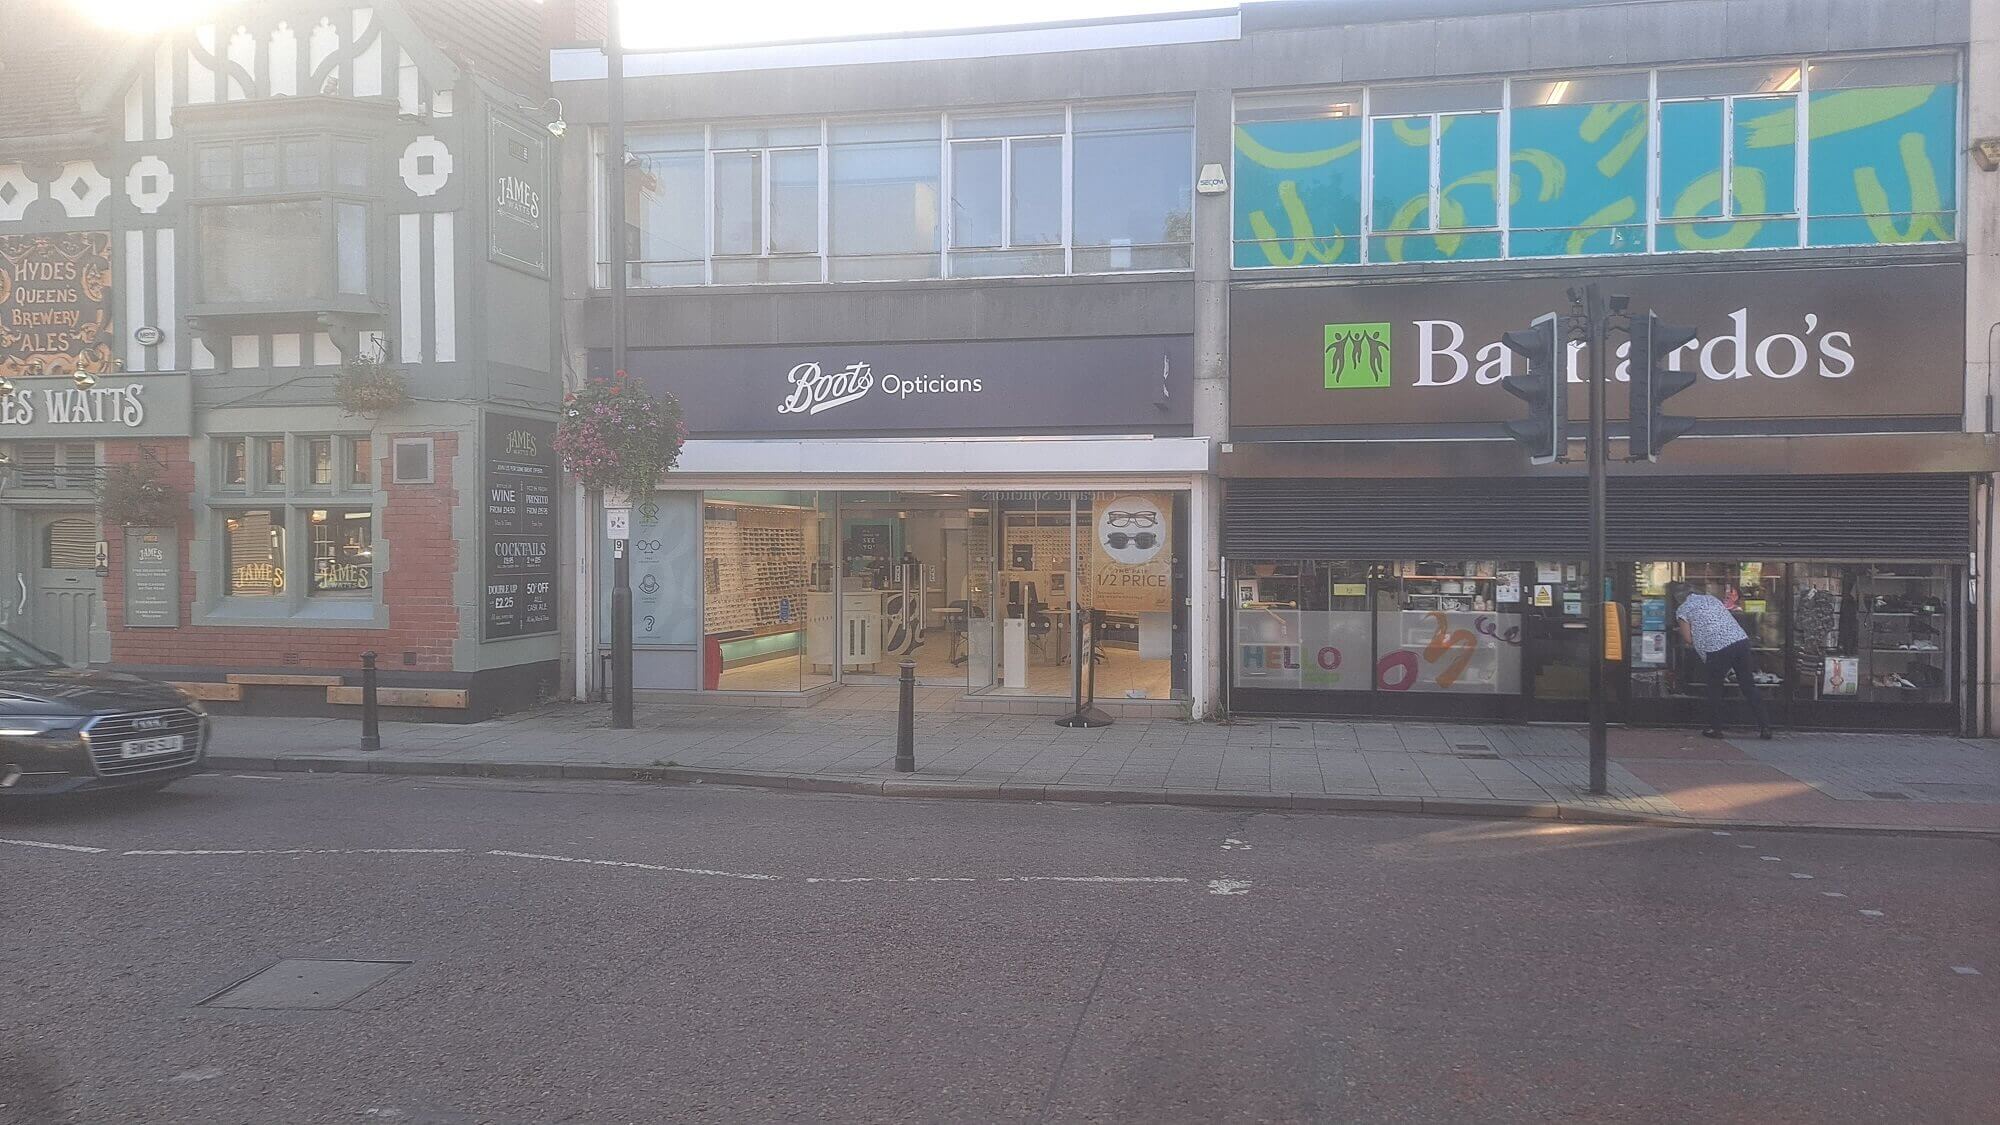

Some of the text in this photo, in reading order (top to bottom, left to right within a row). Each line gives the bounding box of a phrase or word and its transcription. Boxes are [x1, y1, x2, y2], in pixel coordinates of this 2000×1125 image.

[497, 176, 539, 218] JAMES
[14, 259, 77, 281] HYDES
[11, 308, 80, 328] BREWERY
[20, 332, 70, 352] ALES
[777, 361, 983, 415] Boots Opticians
[44, 383, 144, 427] WATTS
[505, 430, 537, 457] JAMES
[492, 489, 516, 502] WINE
[495, 542, 547, 557] COCKTAILS
[616, 540, 623, 549] 9
[235, 562, 284, 588] JAMES
[318, 563, 368, 589] JAMES
[1098, 574, 1167, 587] 1/2 PRICE
